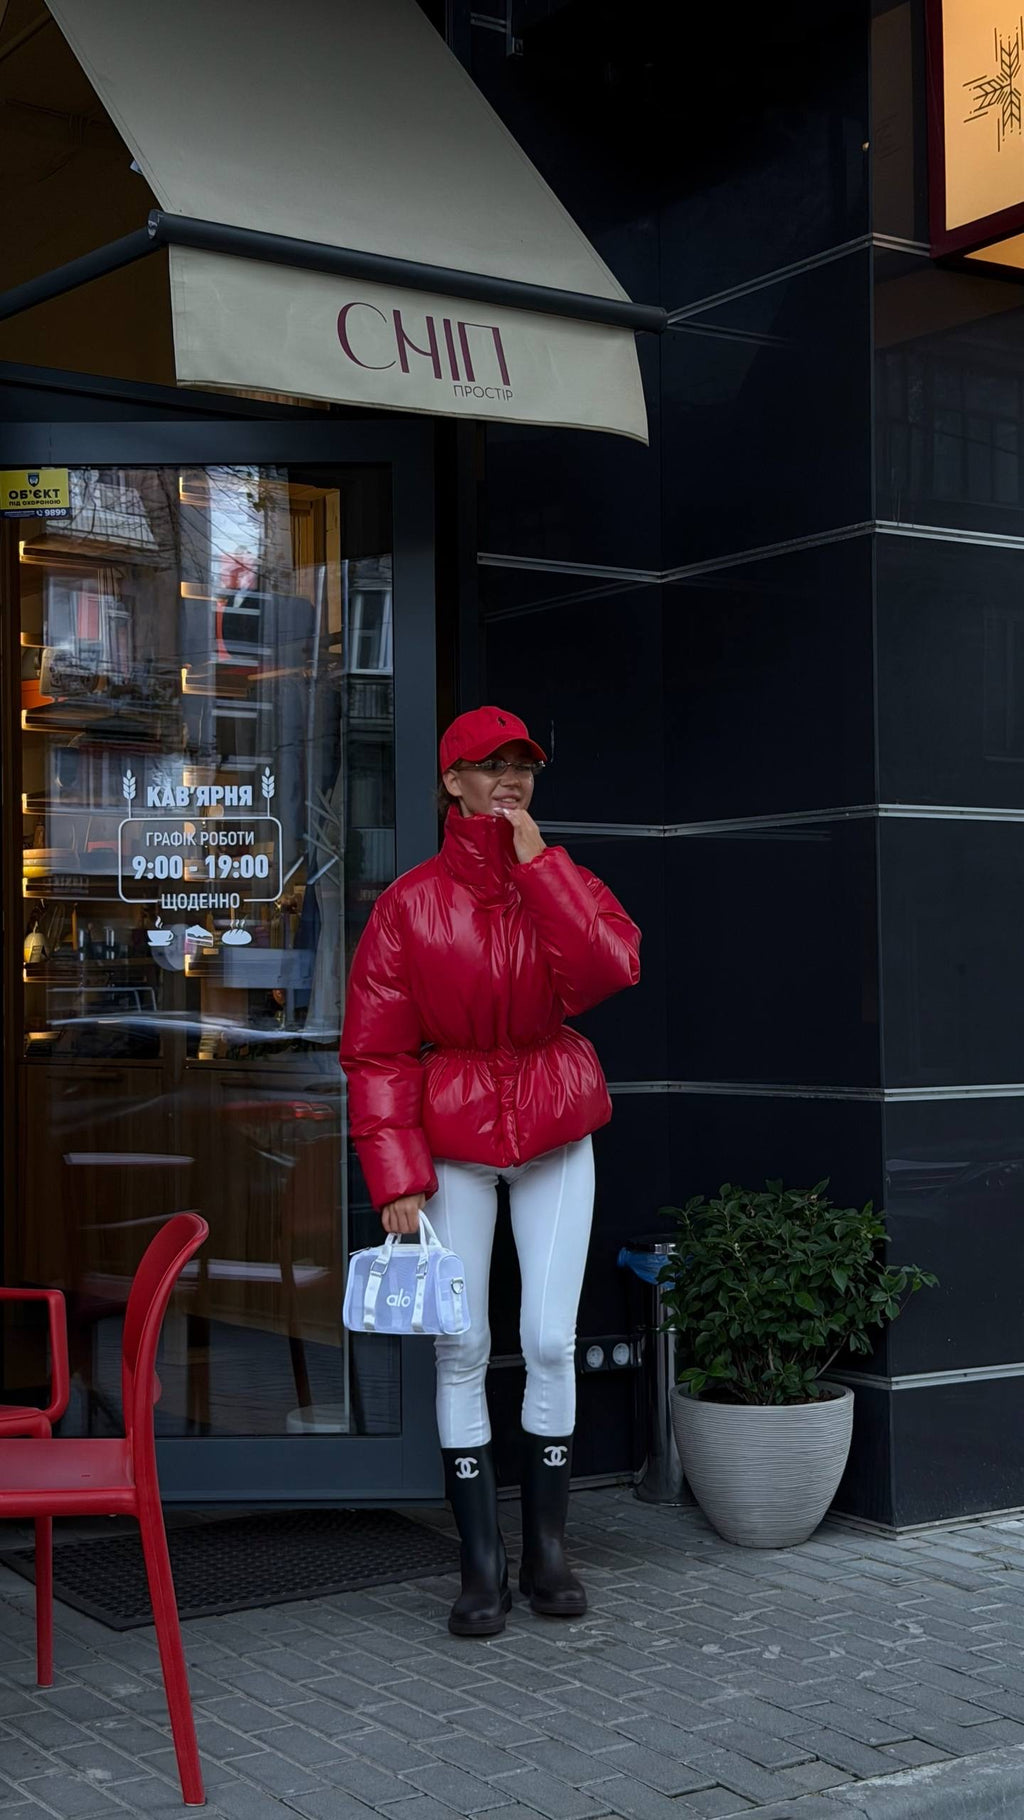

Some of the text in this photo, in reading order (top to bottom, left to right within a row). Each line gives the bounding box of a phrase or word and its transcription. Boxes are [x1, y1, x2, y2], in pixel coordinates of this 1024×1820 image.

[337, 302, 511, 386] СНІП
[453, 384, 513, 401] ПРОСТІР
[9, 489, 60, 499] ОБ'ЄКТ
[44, 508, 67, 516] 9899
[147, 785, 253, 807] КАВ'ЯРНЯ
[146, 831, 255, 847] ГРАФІК РОБОТИ
[132, 855, 184, 880] 9:00
[204, 854, 269, 879] 19:00
[161, 892, 240, 911] ЩОДЕННО
[386, 1288, 411, 1307] alo
